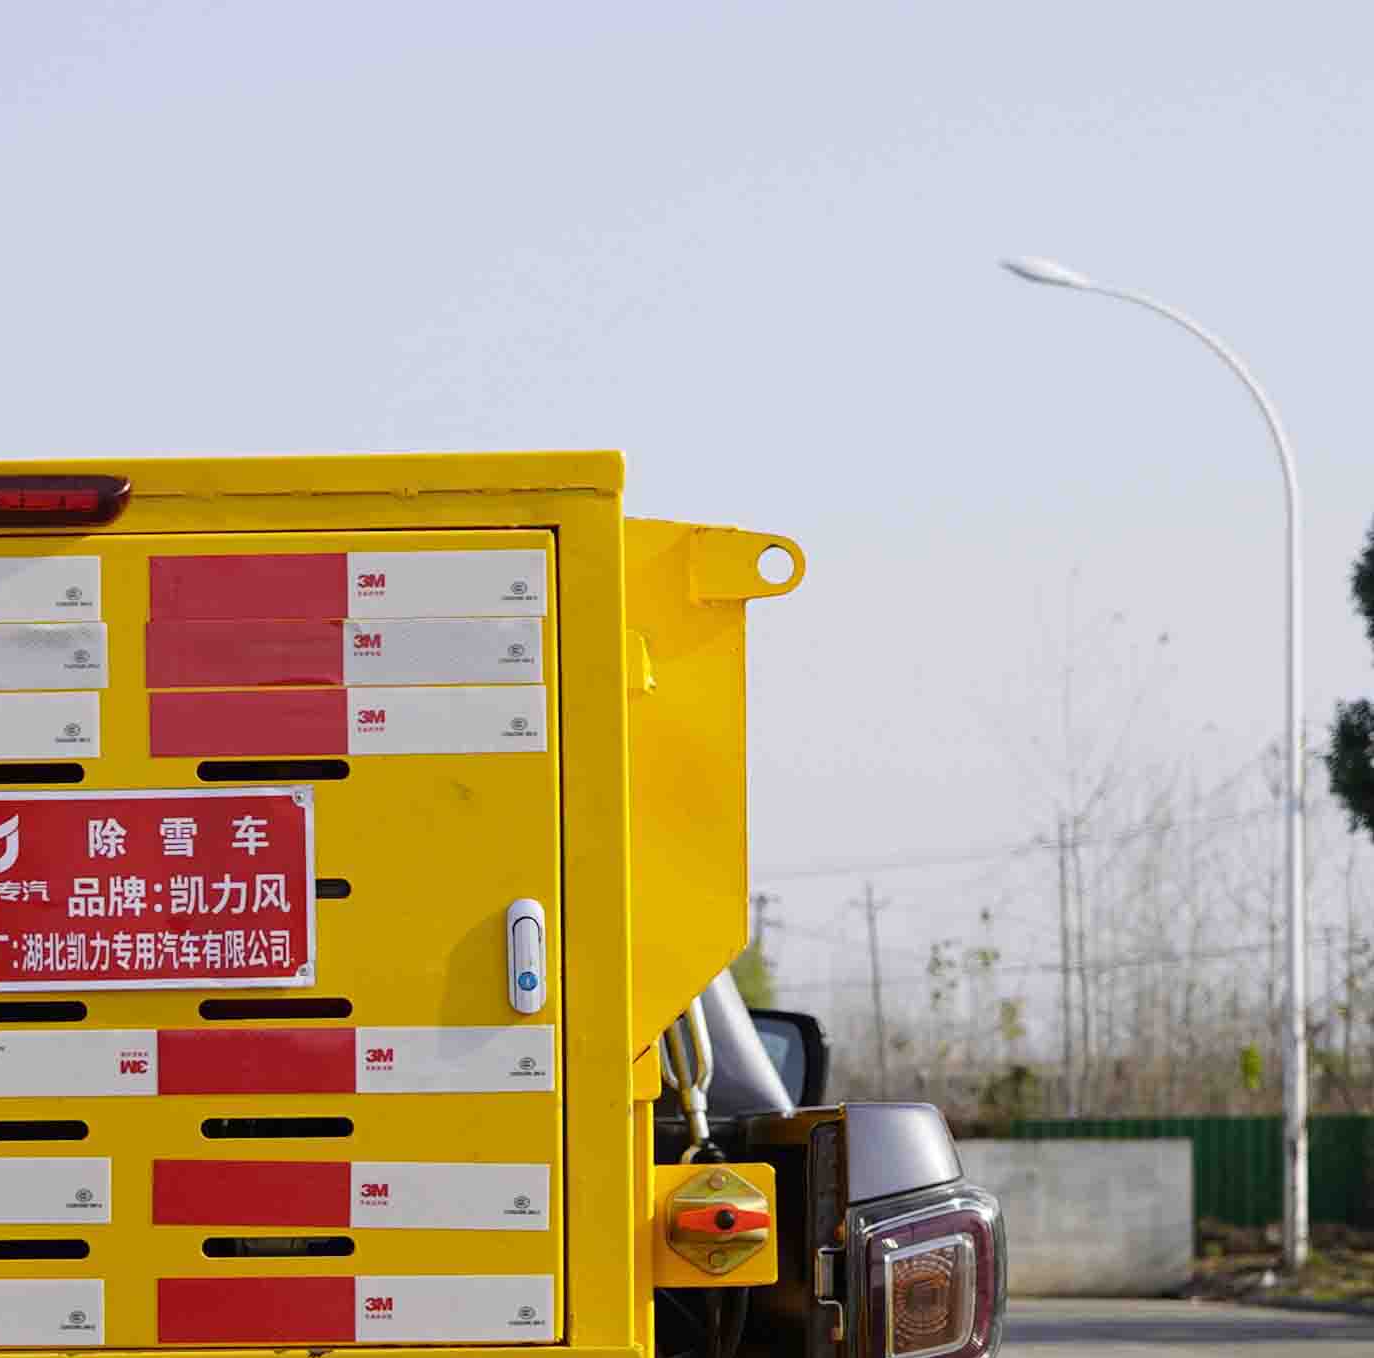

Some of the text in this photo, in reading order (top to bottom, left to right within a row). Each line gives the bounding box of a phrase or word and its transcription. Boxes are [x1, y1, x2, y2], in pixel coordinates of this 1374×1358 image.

[357, 573, 386, 589] 3M
[353, 633, 381, 648] 3M
[358, 709, 385, 724] 3M
[69, 874, 290, 917] 品牌：凯力风
[366, 1048, 393, 1064] 3M
[119, 1058, 146, 1073] 3M
[361, 1184, 389, 1198] 3M
[367, 1297, 395, 1313] 3M
